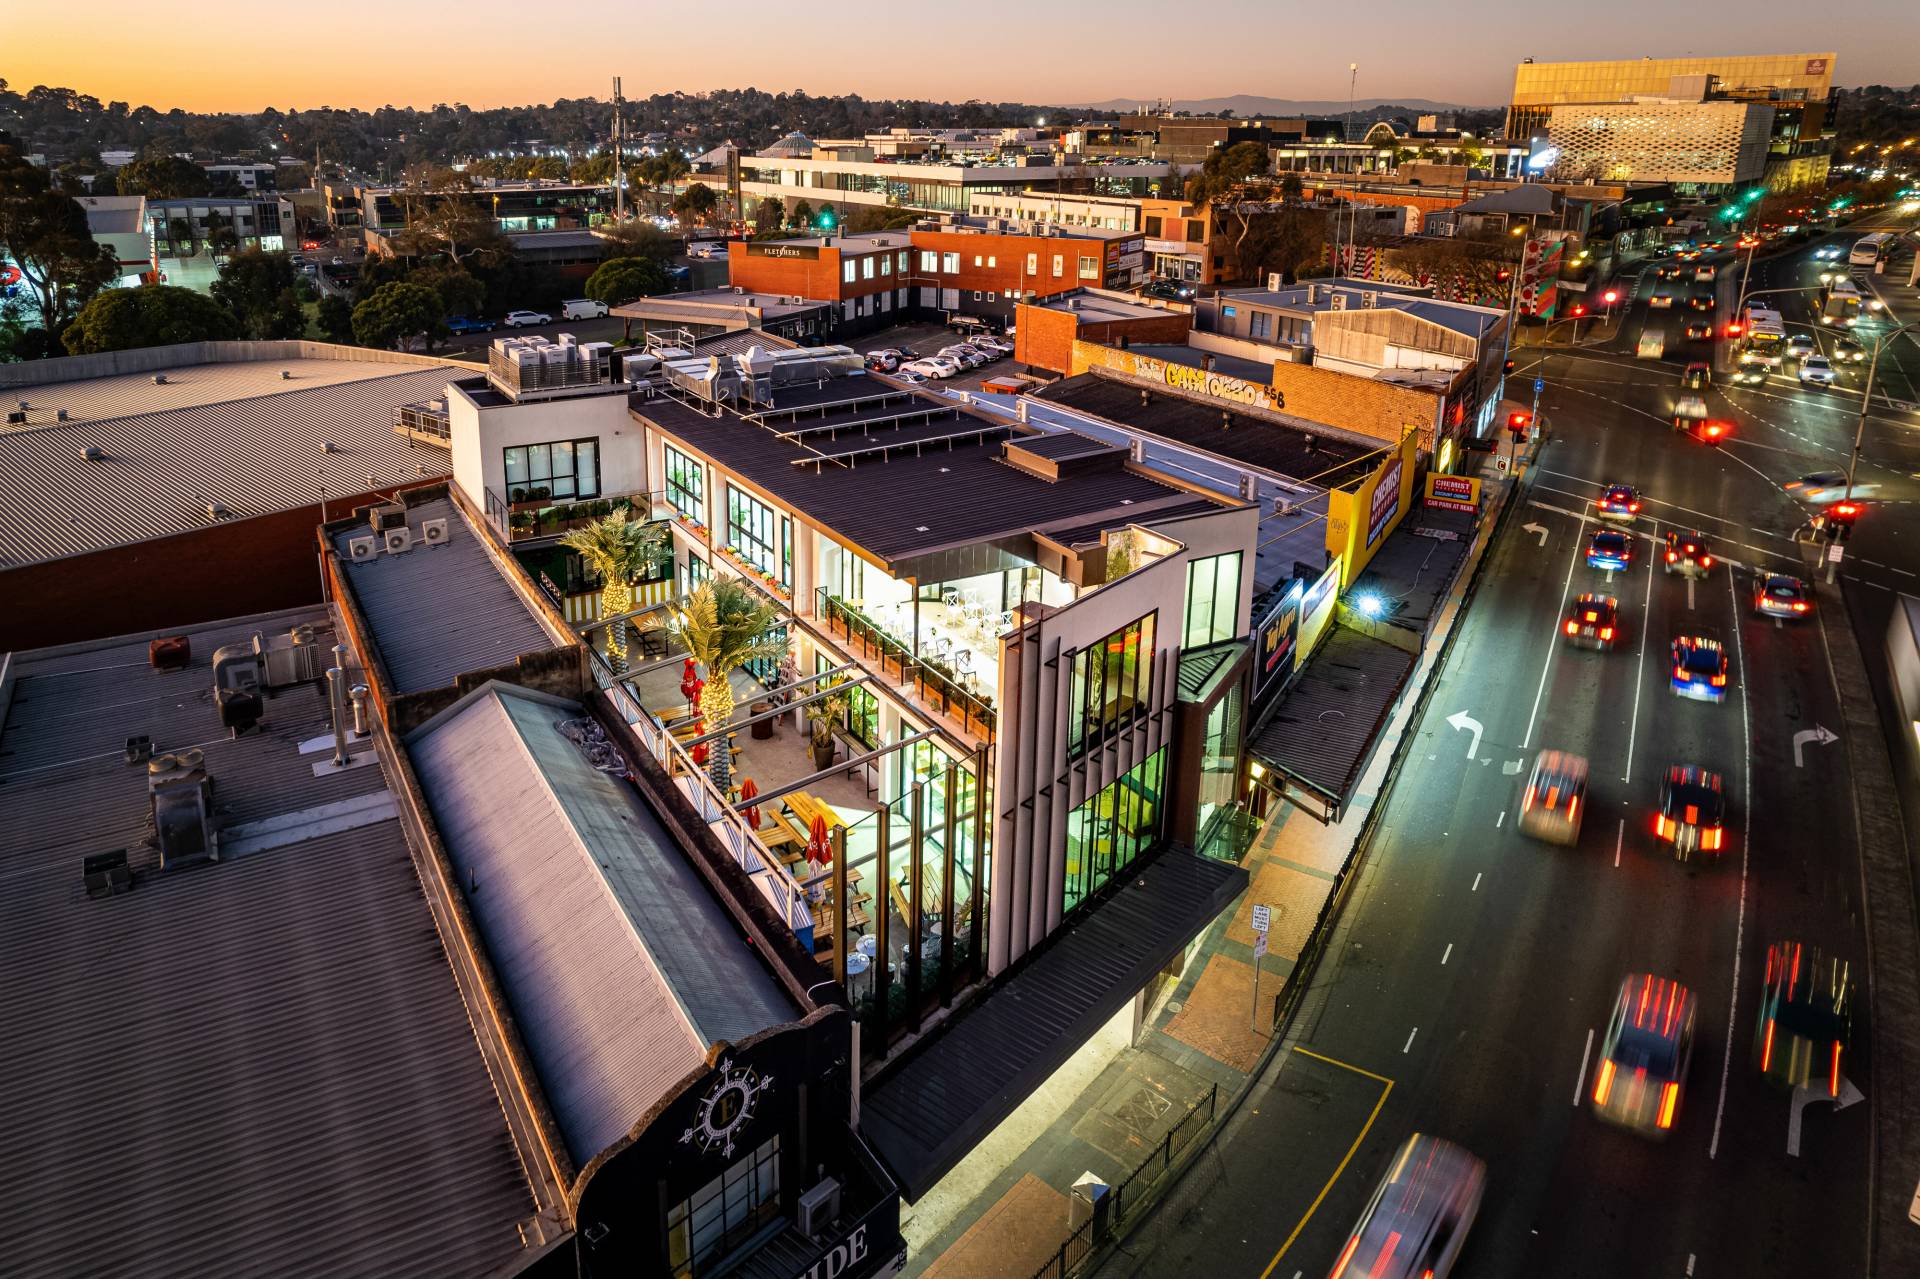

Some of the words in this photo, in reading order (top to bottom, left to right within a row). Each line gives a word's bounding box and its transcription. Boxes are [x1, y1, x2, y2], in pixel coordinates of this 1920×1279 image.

[1372, 462, 1402, 512] CHEMIST
[1435, 479, 1470, 490] CHEMIST
[1427, 499, 1438, 507] CAR
[1438, 501, 1452, 509] PARK
